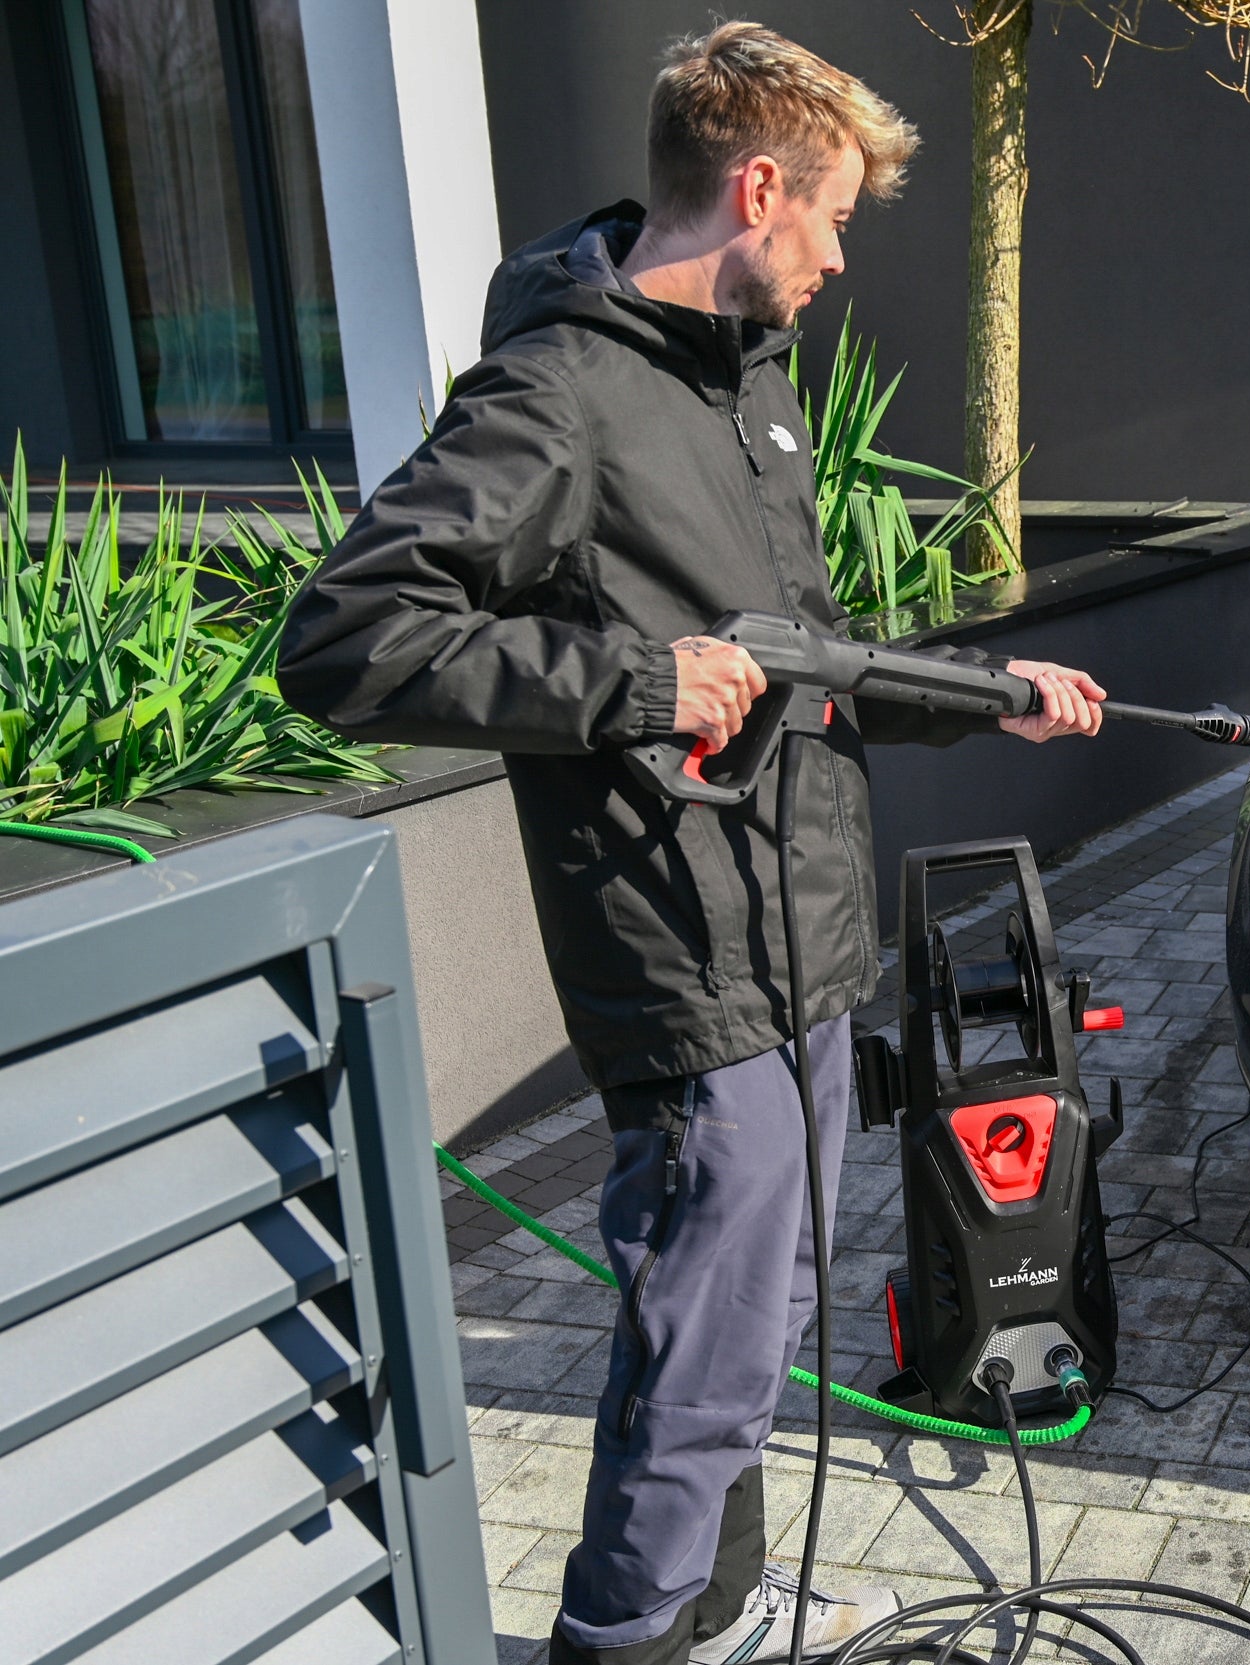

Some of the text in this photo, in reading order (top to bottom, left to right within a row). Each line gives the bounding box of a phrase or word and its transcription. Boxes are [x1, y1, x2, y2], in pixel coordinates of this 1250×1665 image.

[697, 1115, 739, 1130] QUECHUA
[989, 1266, 1059, 1288] LEHMANN
[1030, 1275, 1059, 1287] GARDEN
